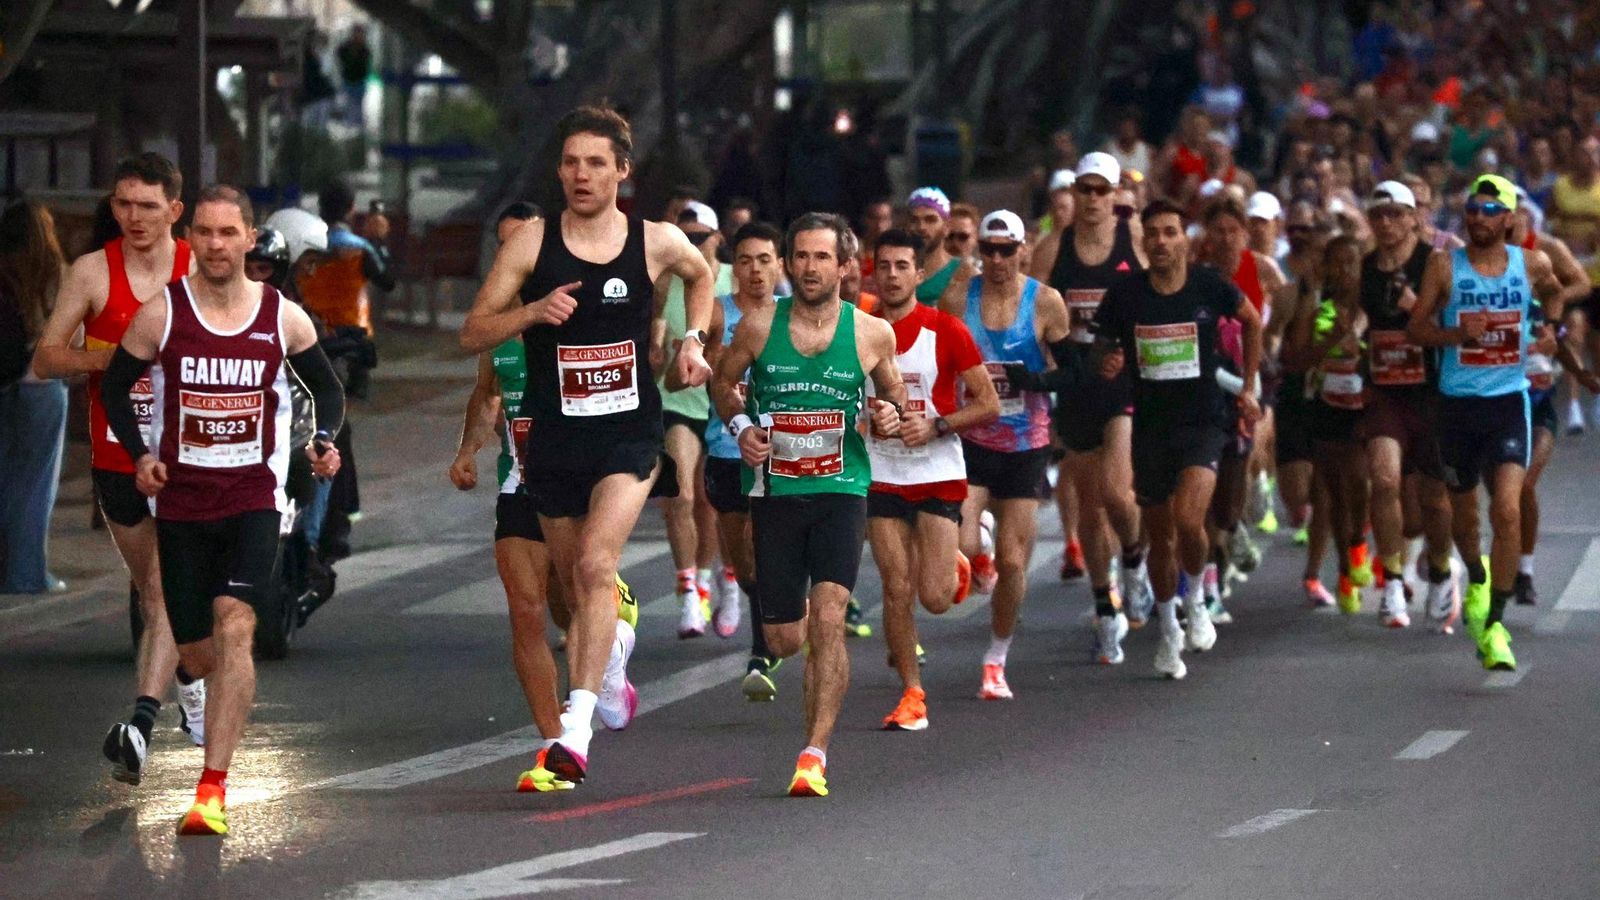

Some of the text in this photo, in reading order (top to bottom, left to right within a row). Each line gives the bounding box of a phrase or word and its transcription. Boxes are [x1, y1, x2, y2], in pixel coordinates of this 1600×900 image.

[1461, 287, 1522, 309] nerja
[578, 345, 629, 360] GENERALI
[181, 356, 266, 387] GALWAY
[576, 368, 621, 385] 11626
[202, 395, 258, 409] GENERALI
[197, 420, 246, 434] 13623
[788, 414, 838, 426] GENERALI
[788, 435, 824, 449] 7903
